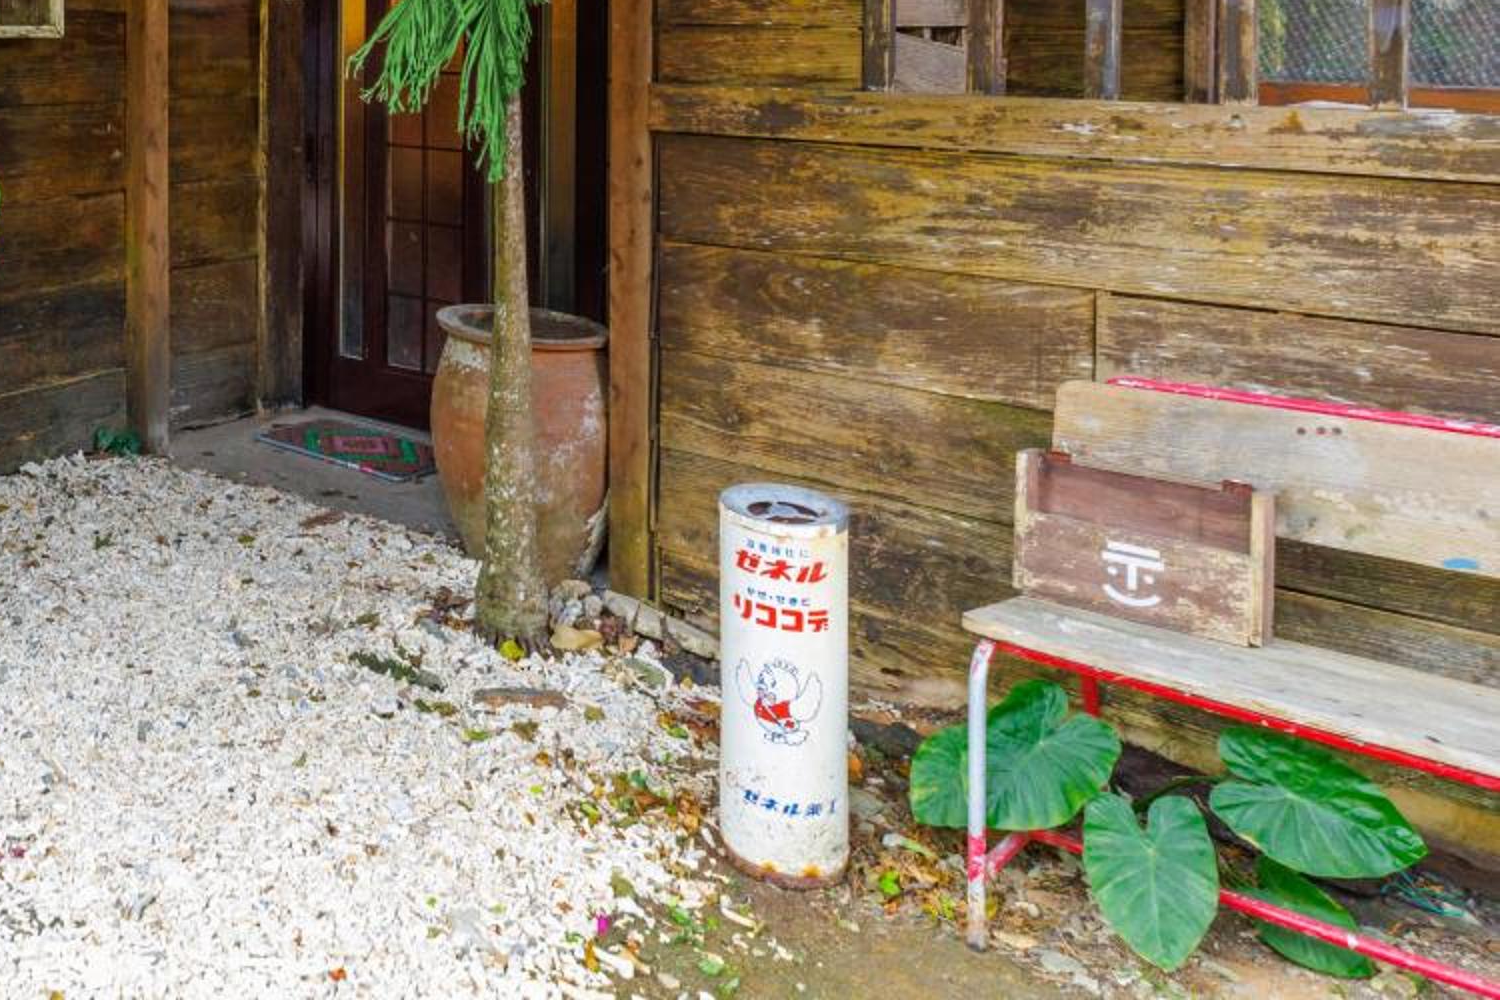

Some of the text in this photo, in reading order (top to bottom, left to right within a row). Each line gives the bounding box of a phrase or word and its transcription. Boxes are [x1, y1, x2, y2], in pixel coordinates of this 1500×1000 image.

[735, 549, 829, 584] ゼネル
[734, 593, 829, 633] リココデ
